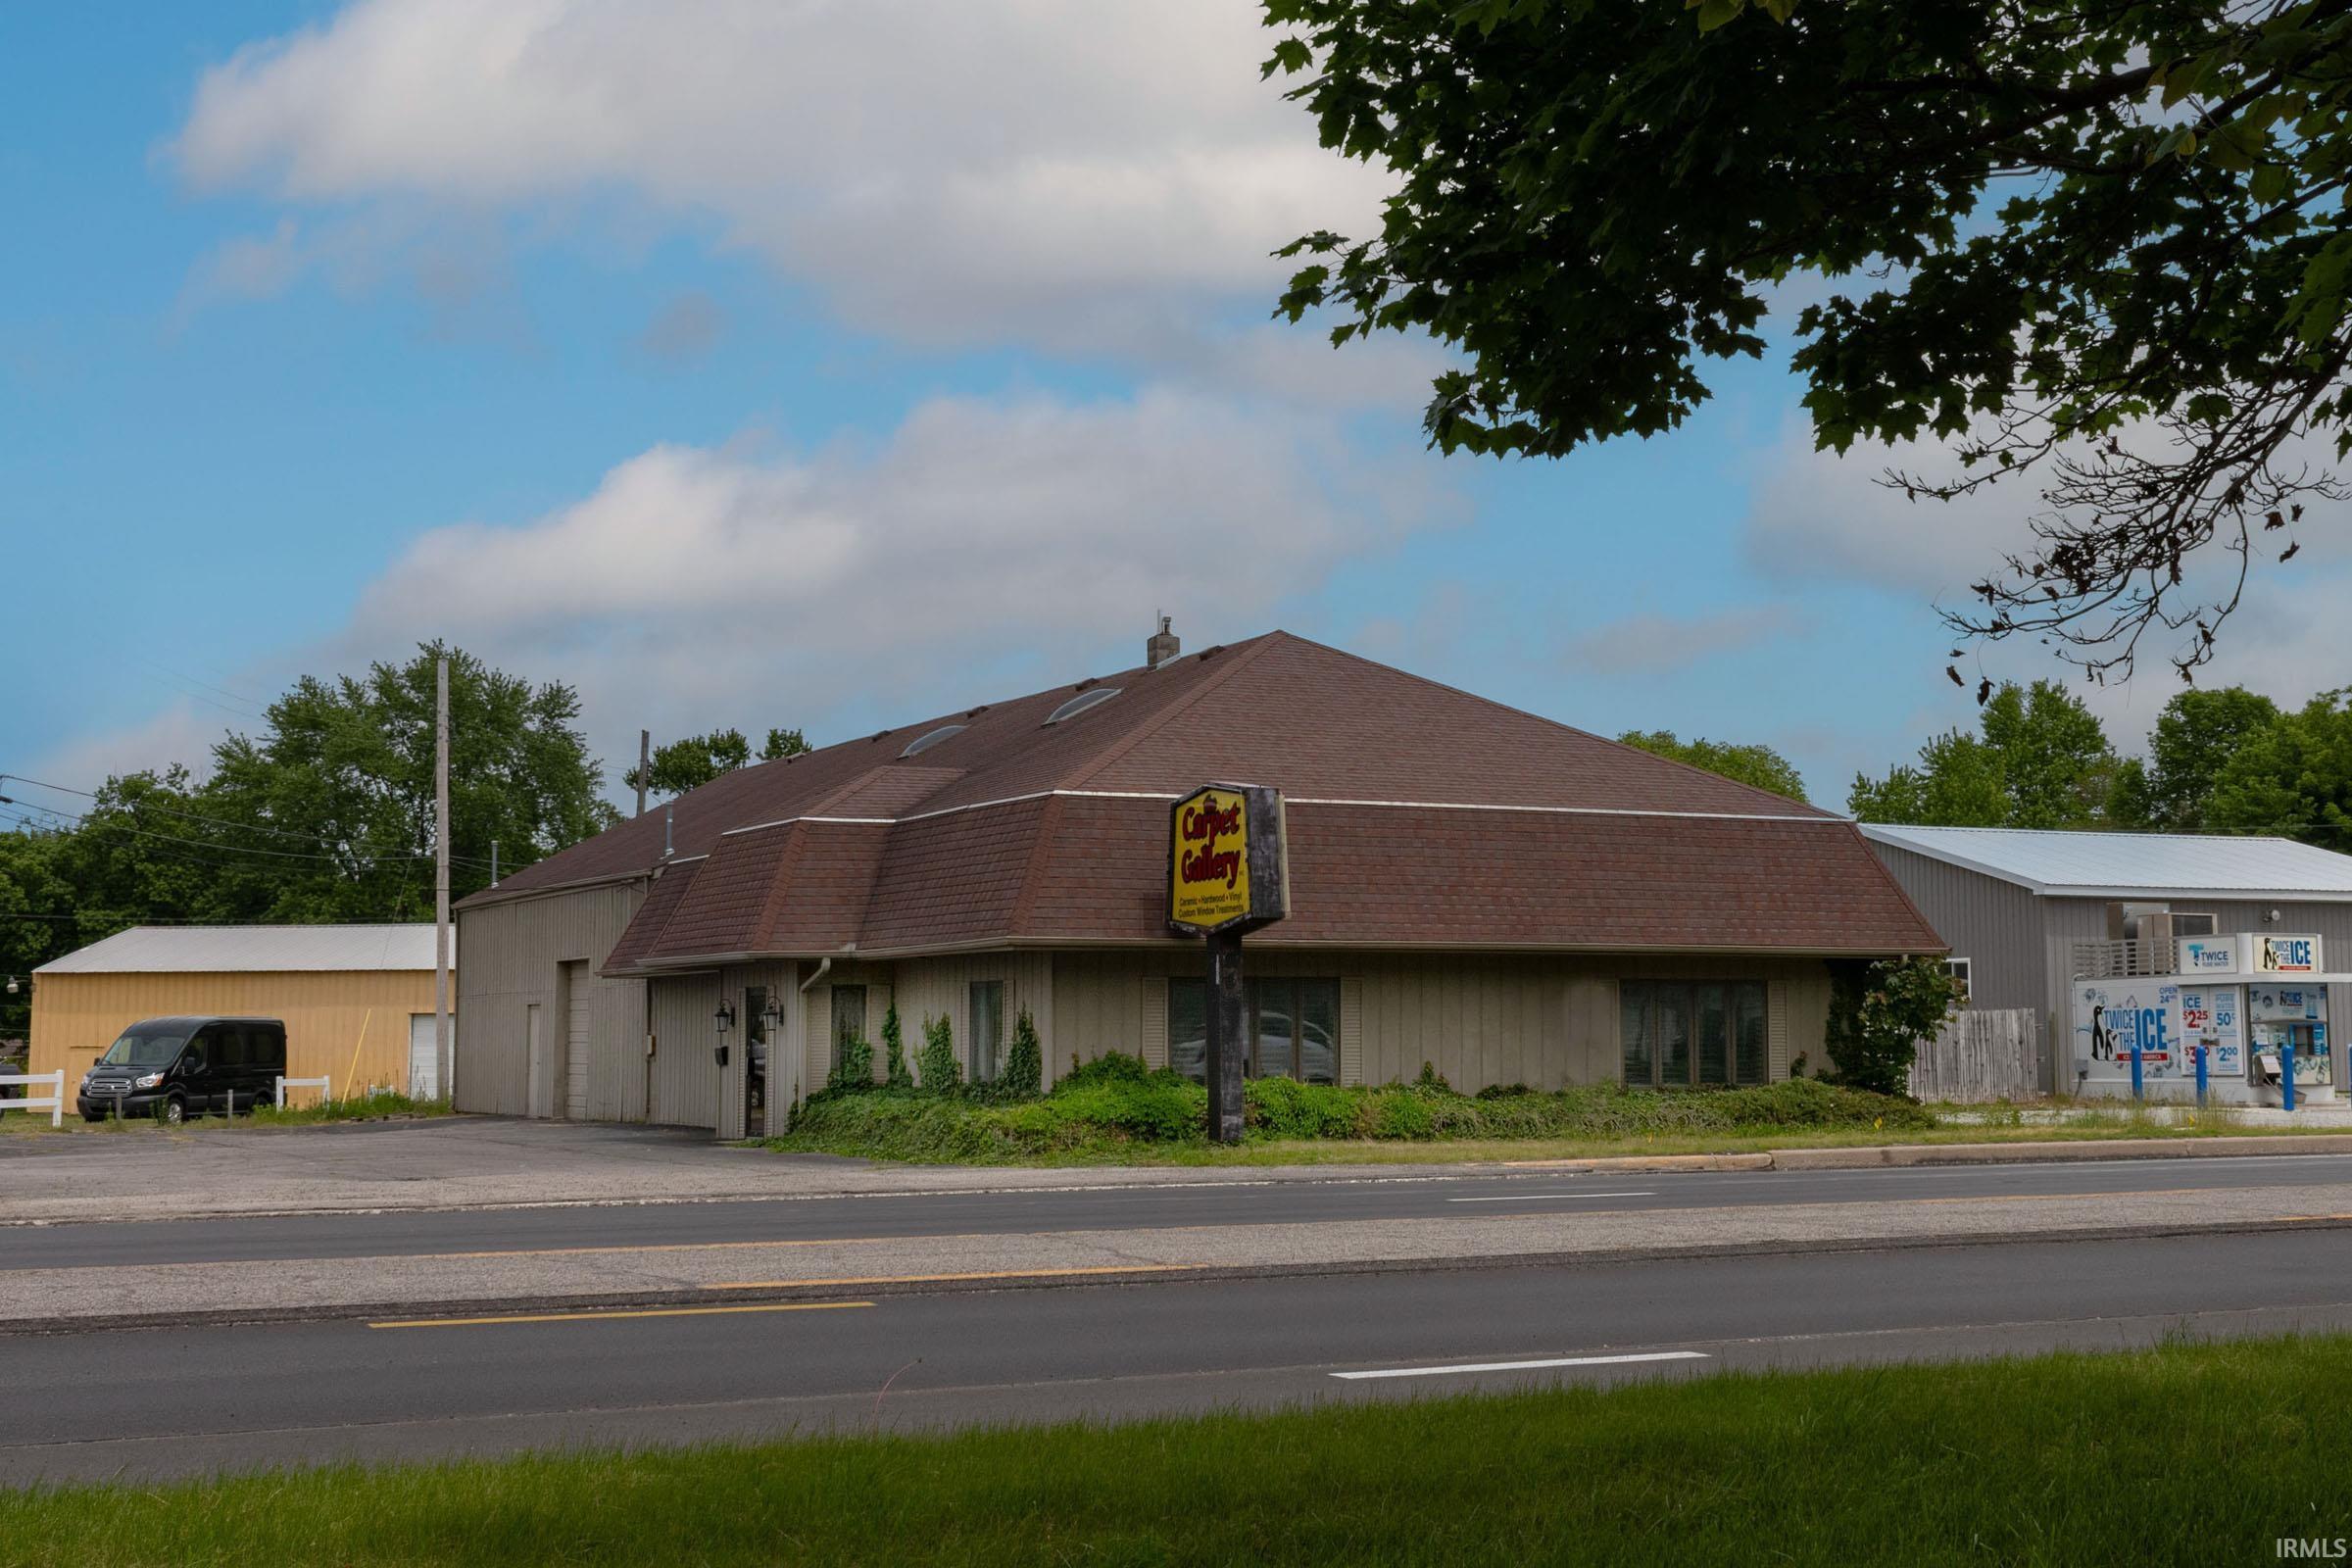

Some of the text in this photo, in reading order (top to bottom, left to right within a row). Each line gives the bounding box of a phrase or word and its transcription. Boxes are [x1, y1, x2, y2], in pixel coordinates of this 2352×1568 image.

[1182, 802, 1240, 847] Carpet
[1181, 844, 1241, 890] Gallery
[1229, 892, 1243, 902] Vinyl
[2271, 940, 2289, 953] TWICE
[2289, 940, 2311, 964] ICE
[2201, 951, 2229, 961] TWICE
[2279, 953, 2290, 964] THE
[2182, 997, 2201, 1008] ICE
[2104, 1009, 2133, 1030] TWICE
[2134, 1008, 2167, 1051] ICE
